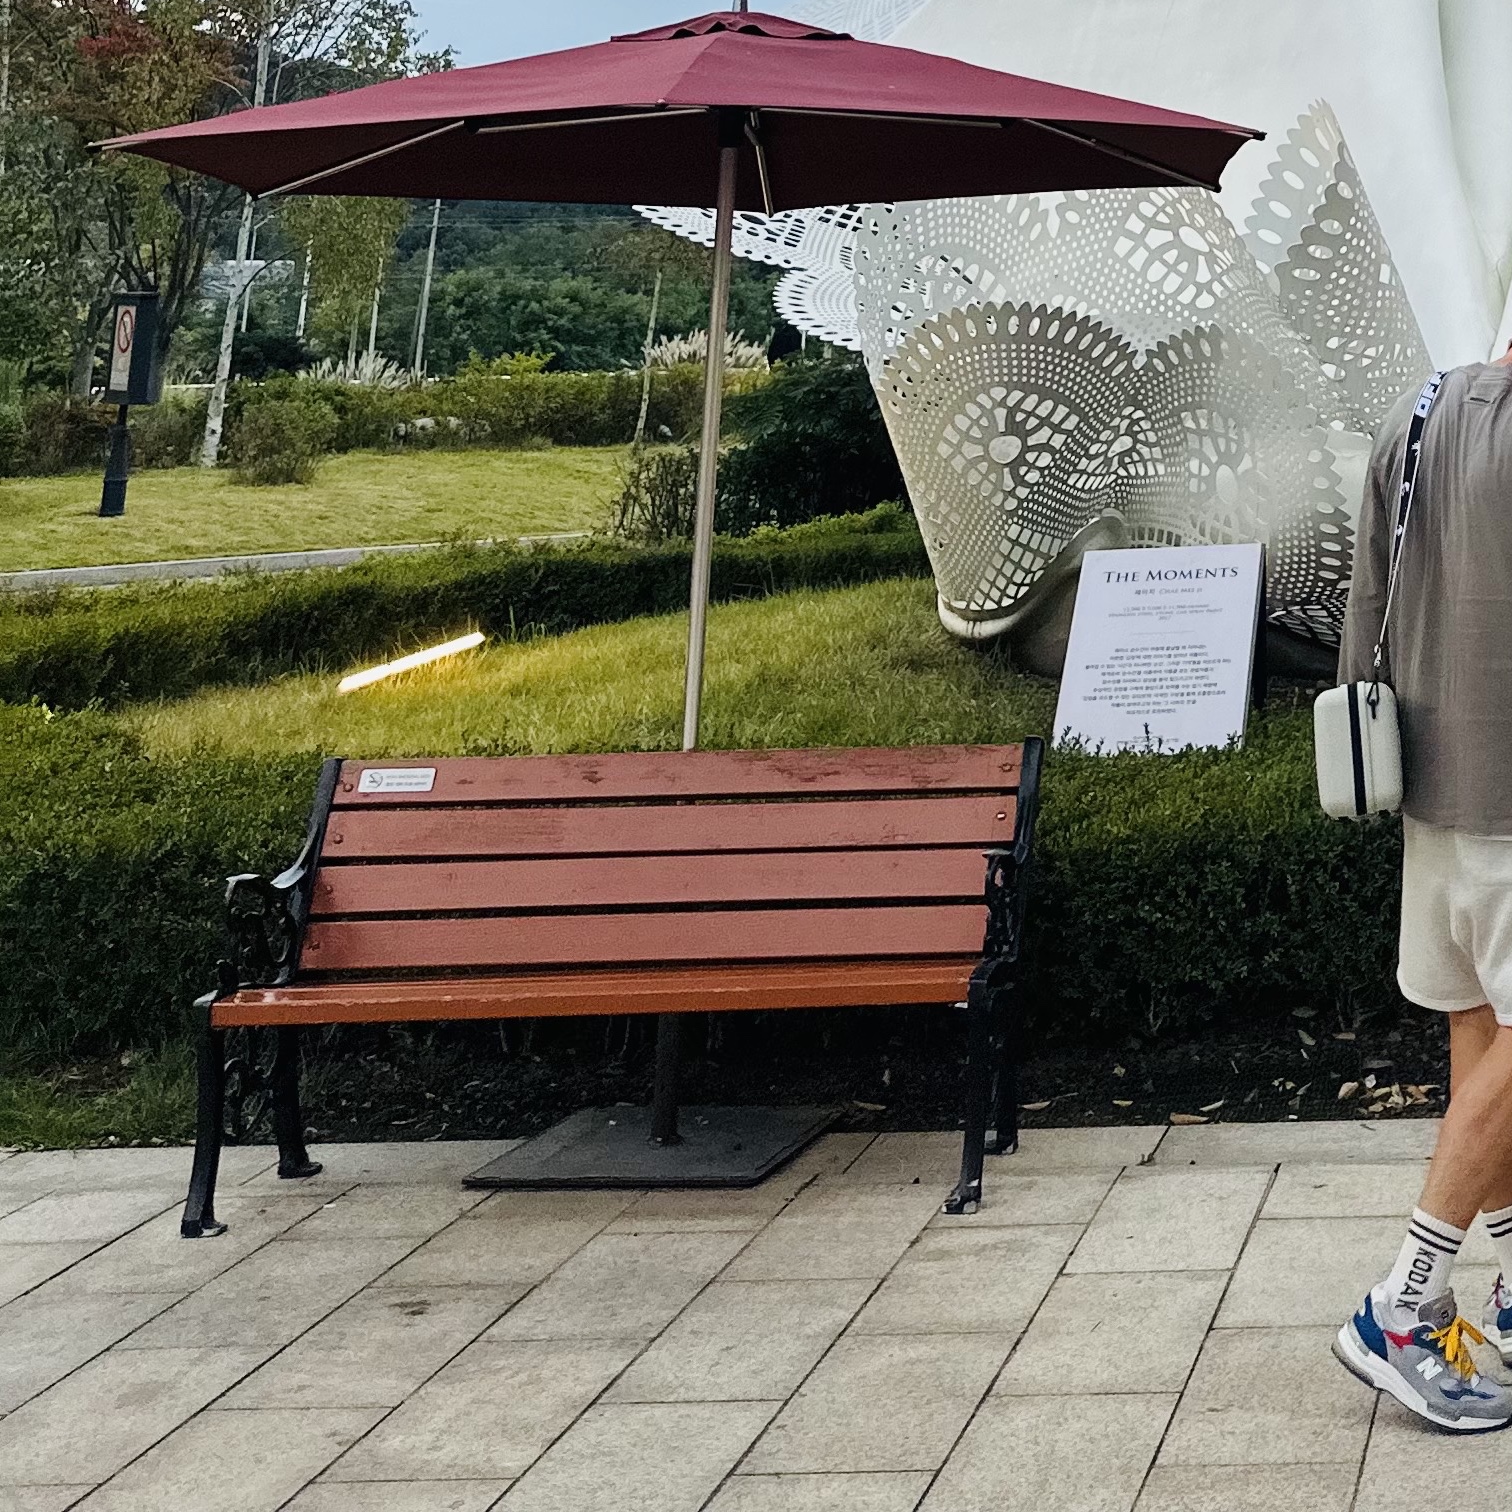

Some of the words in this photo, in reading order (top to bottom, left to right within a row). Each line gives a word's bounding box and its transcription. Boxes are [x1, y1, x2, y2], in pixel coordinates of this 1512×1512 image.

[1103, 571, 1140, 583] THE
[1145, 567, 1239, 582] MOMENTS
[1395, 1246, 1437, 1312] KODAK
[1416, 1356, 1443, 1381] N
